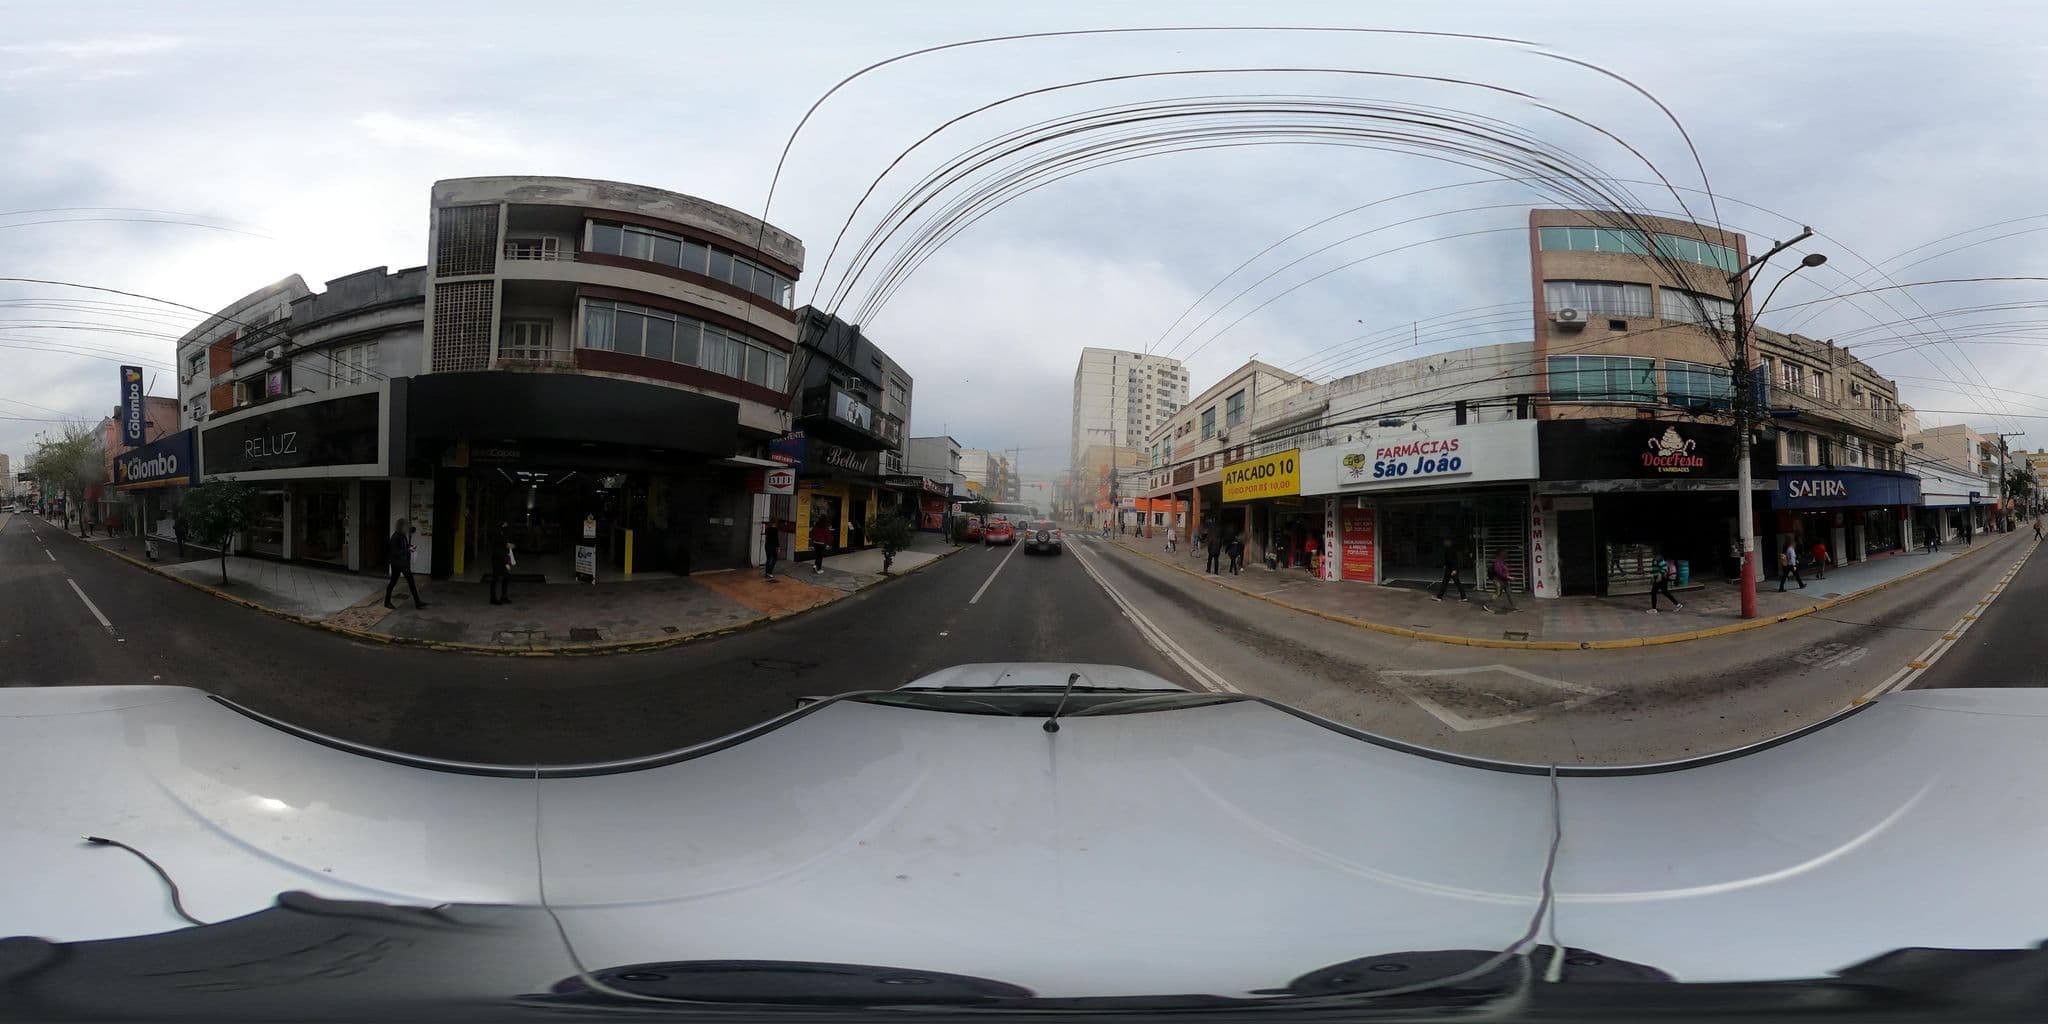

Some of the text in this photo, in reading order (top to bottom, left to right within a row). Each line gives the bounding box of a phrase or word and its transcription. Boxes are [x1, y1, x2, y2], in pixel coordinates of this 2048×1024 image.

[129, 384, 140, 440] Colombo
[245, 432, 297, 458] RELUZ
[1376, 438, 1459, 459] FARMÁCIAS
[128, 452, 177, 480] Colombo
[1225, 459, 1293, 485] ATACADO 10
[1373, 453, 1461, 478] São João
[1642, 452, 1704, 467] DoceFesta
[1789, 480, 1847, 498] SAFIRA
